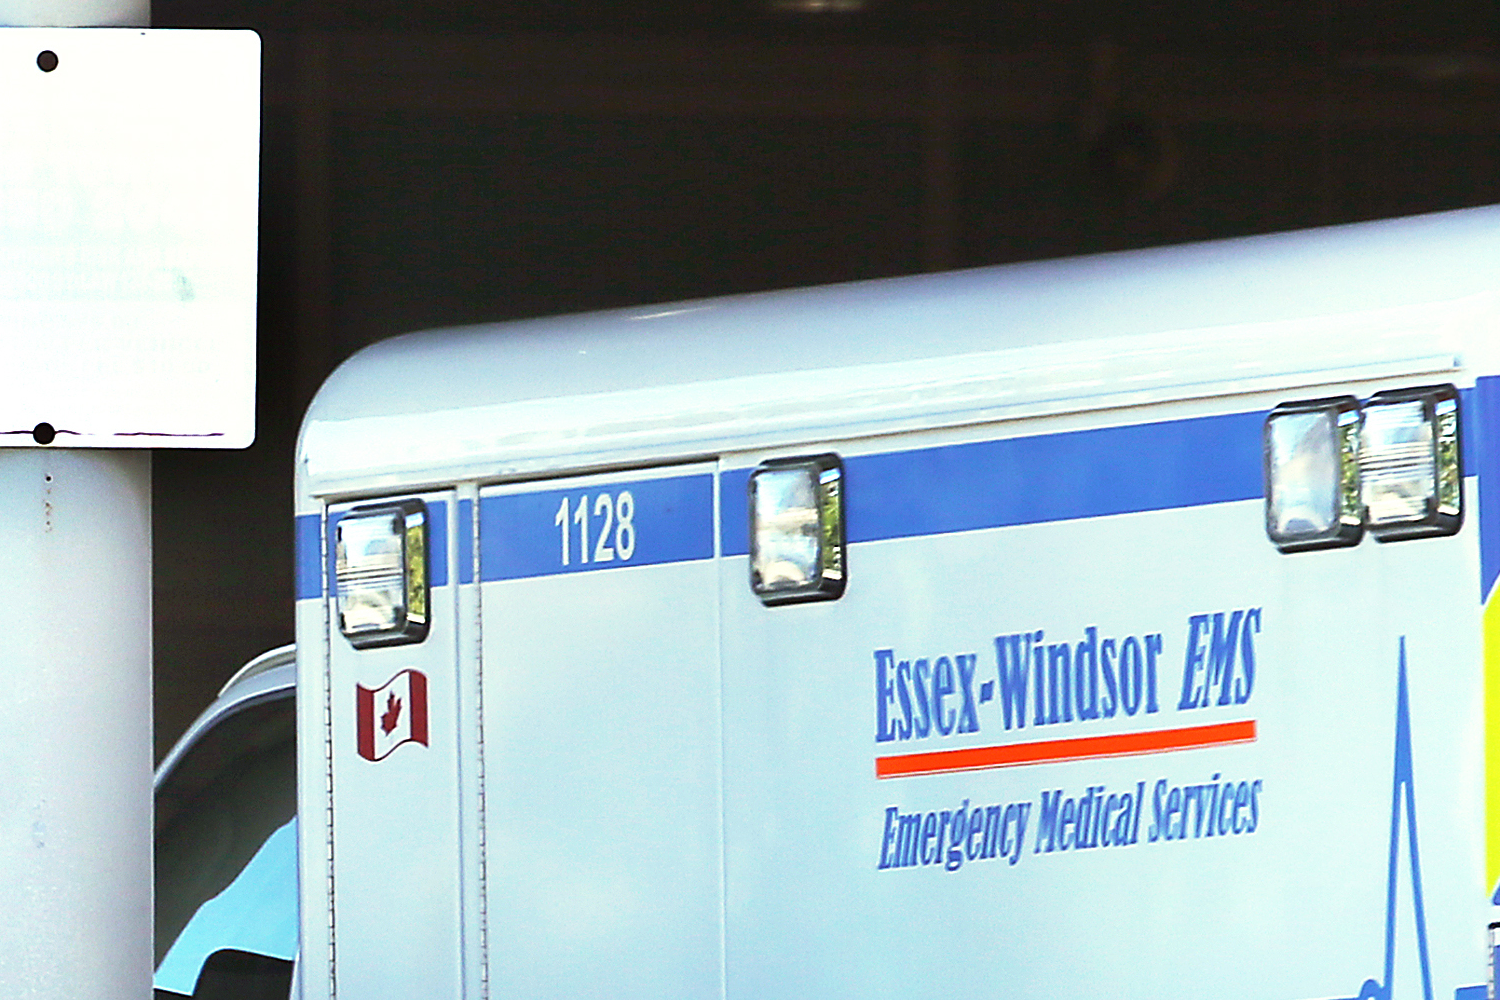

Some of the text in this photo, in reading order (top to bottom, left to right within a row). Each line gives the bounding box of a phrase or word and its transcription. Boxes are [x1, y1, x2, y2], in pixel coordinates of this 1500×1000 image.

[554, 490, 636, 566] 1128
[873, 607, 1262, 742] Essex-Windsor EMS
[878, 773, 1263, 871] Emergency Medical Services
